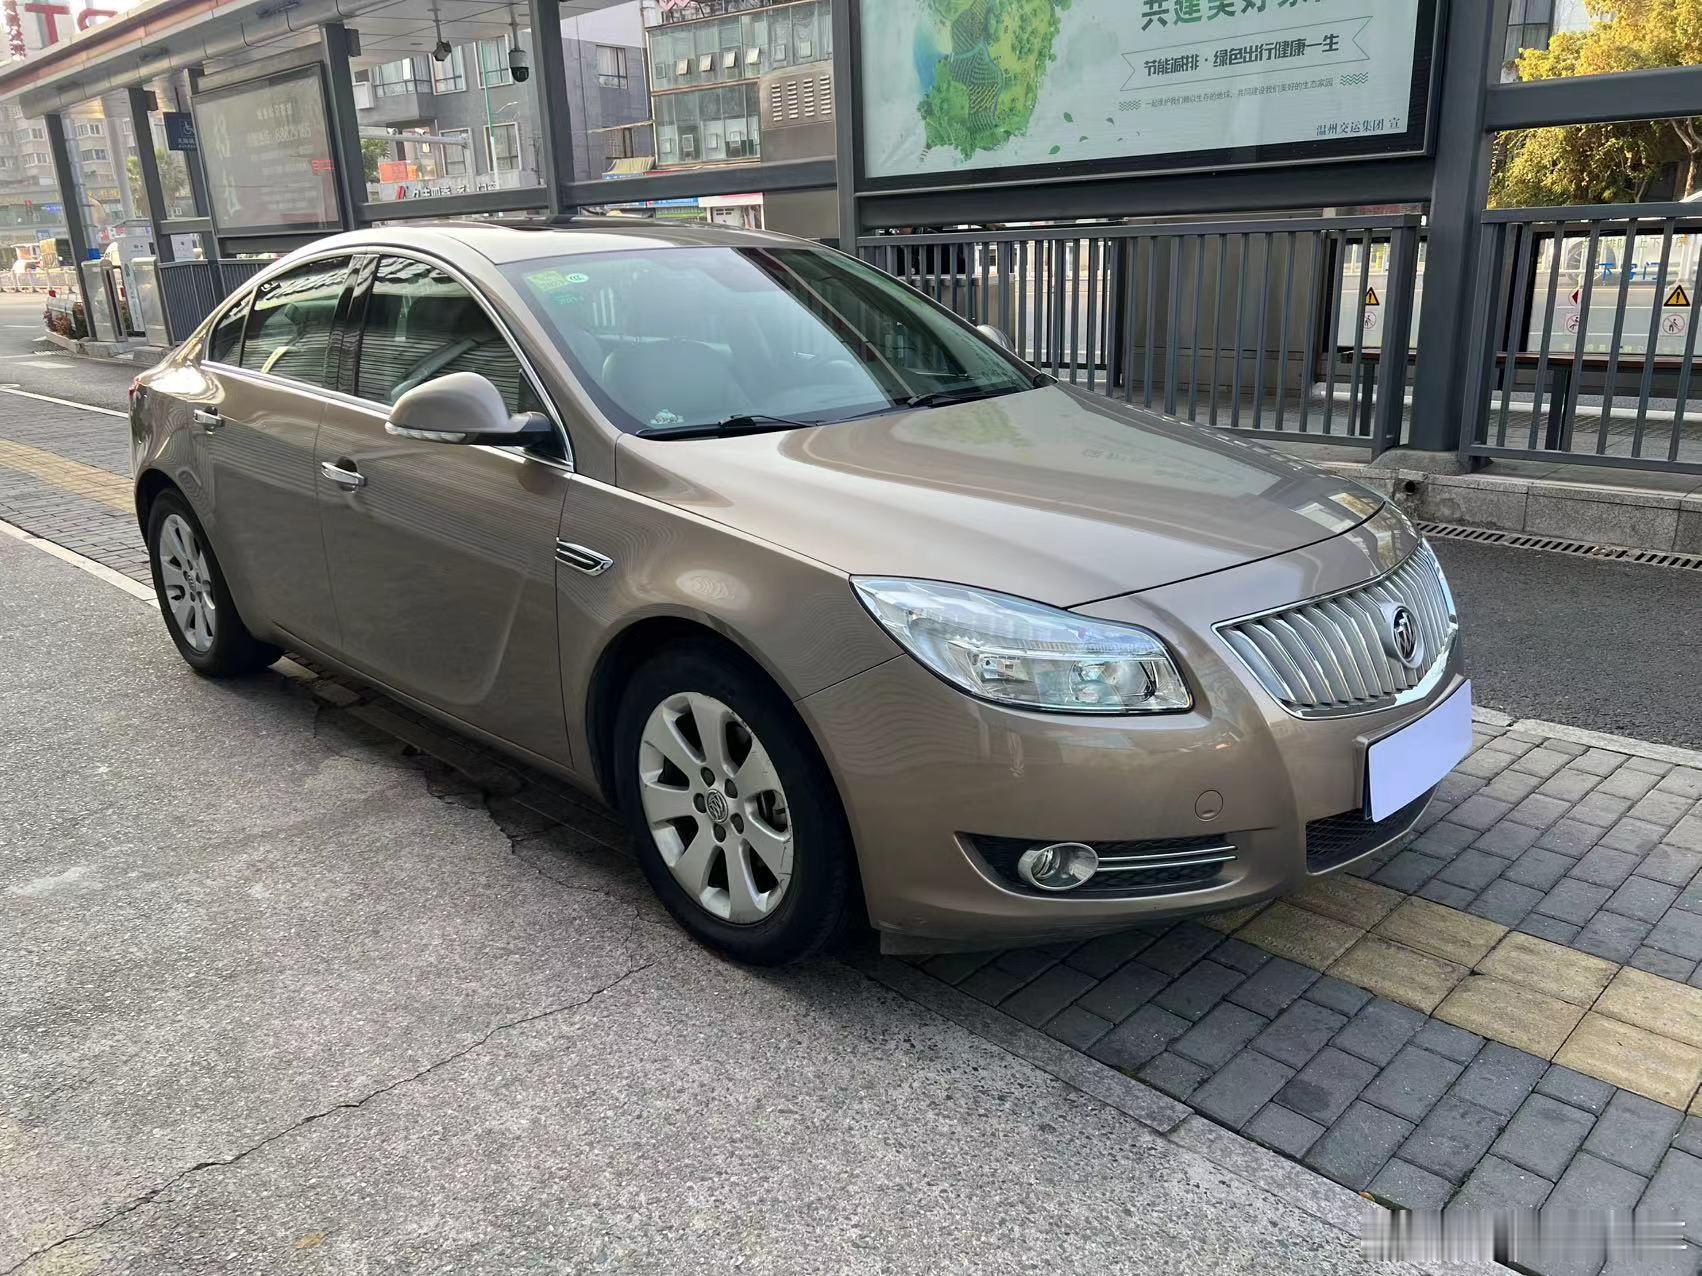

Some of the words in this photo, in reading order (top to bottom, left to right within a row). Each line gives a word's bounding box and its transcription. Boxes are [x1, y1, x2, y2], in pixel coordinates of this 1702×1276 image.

[1316, 118, 1384, 136] 温州交运集团
